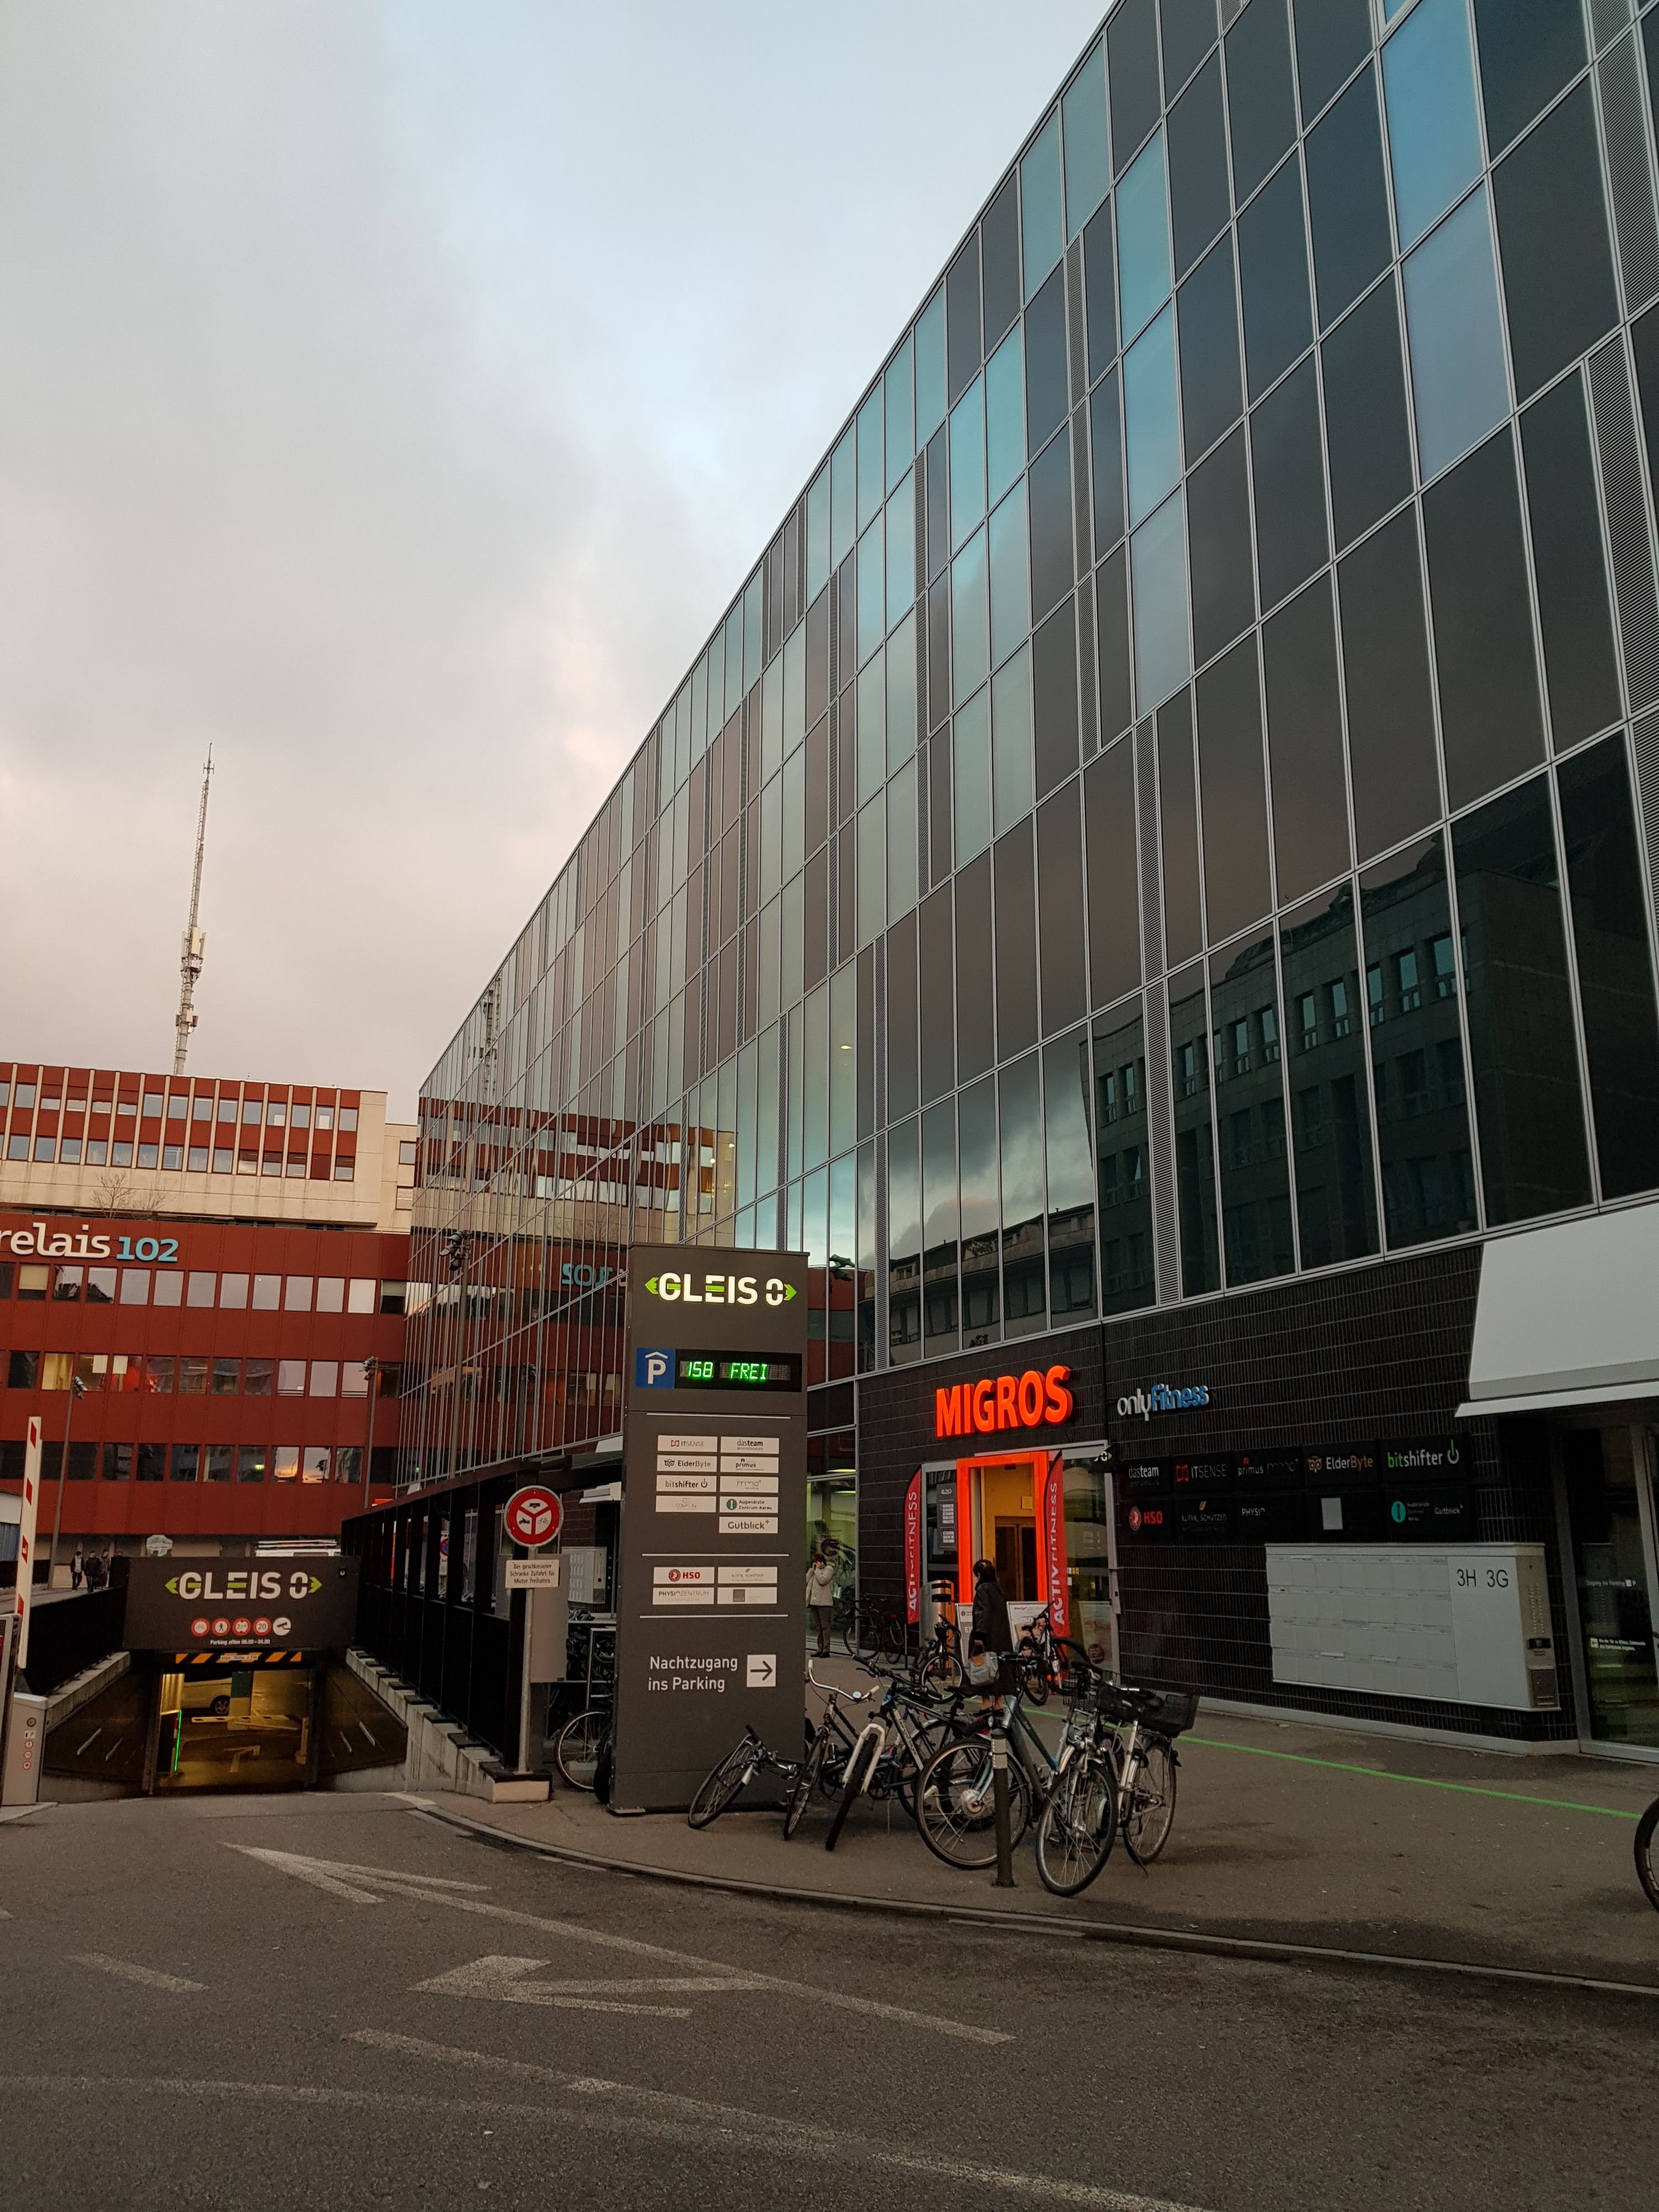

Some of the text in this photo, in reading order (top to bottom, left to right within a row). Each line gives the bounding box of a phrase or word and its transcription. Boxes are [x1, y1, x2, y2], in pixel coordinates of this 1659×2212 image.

[0, 1222, 179, 1262] relais 102
[659, 1272, 758, 1305] GLEIS
[765, 1278, 784, 1306] 0
[688, 1361, 768, 1380] 158 FREI
[936, 1365, 1073, 1438] MIGROS
[677, 1460, 711, 1468] ElderByte
[1326, 1454, 1374, 1472] ElderByte
[1387, 1448, 1443, 1468] bitshifter
[1128, 1464, 1160, 1478] dasteam
[1191, 1464, 1227, 1478] ITSENSE
[1238, 1465, 1264, 1477] primus
[665, 1480, 699, 1488] bitshifter
[1143, 1510, 1164, 1525] HSO
[179, 1572, 309, 1600] GLEIS 0
[1457, 1568, 1509, 1588] 3H 3G
[650, 1656, 738, 1672] Nachtzugang
[648, 1676, 725, 1693] ins Parking
